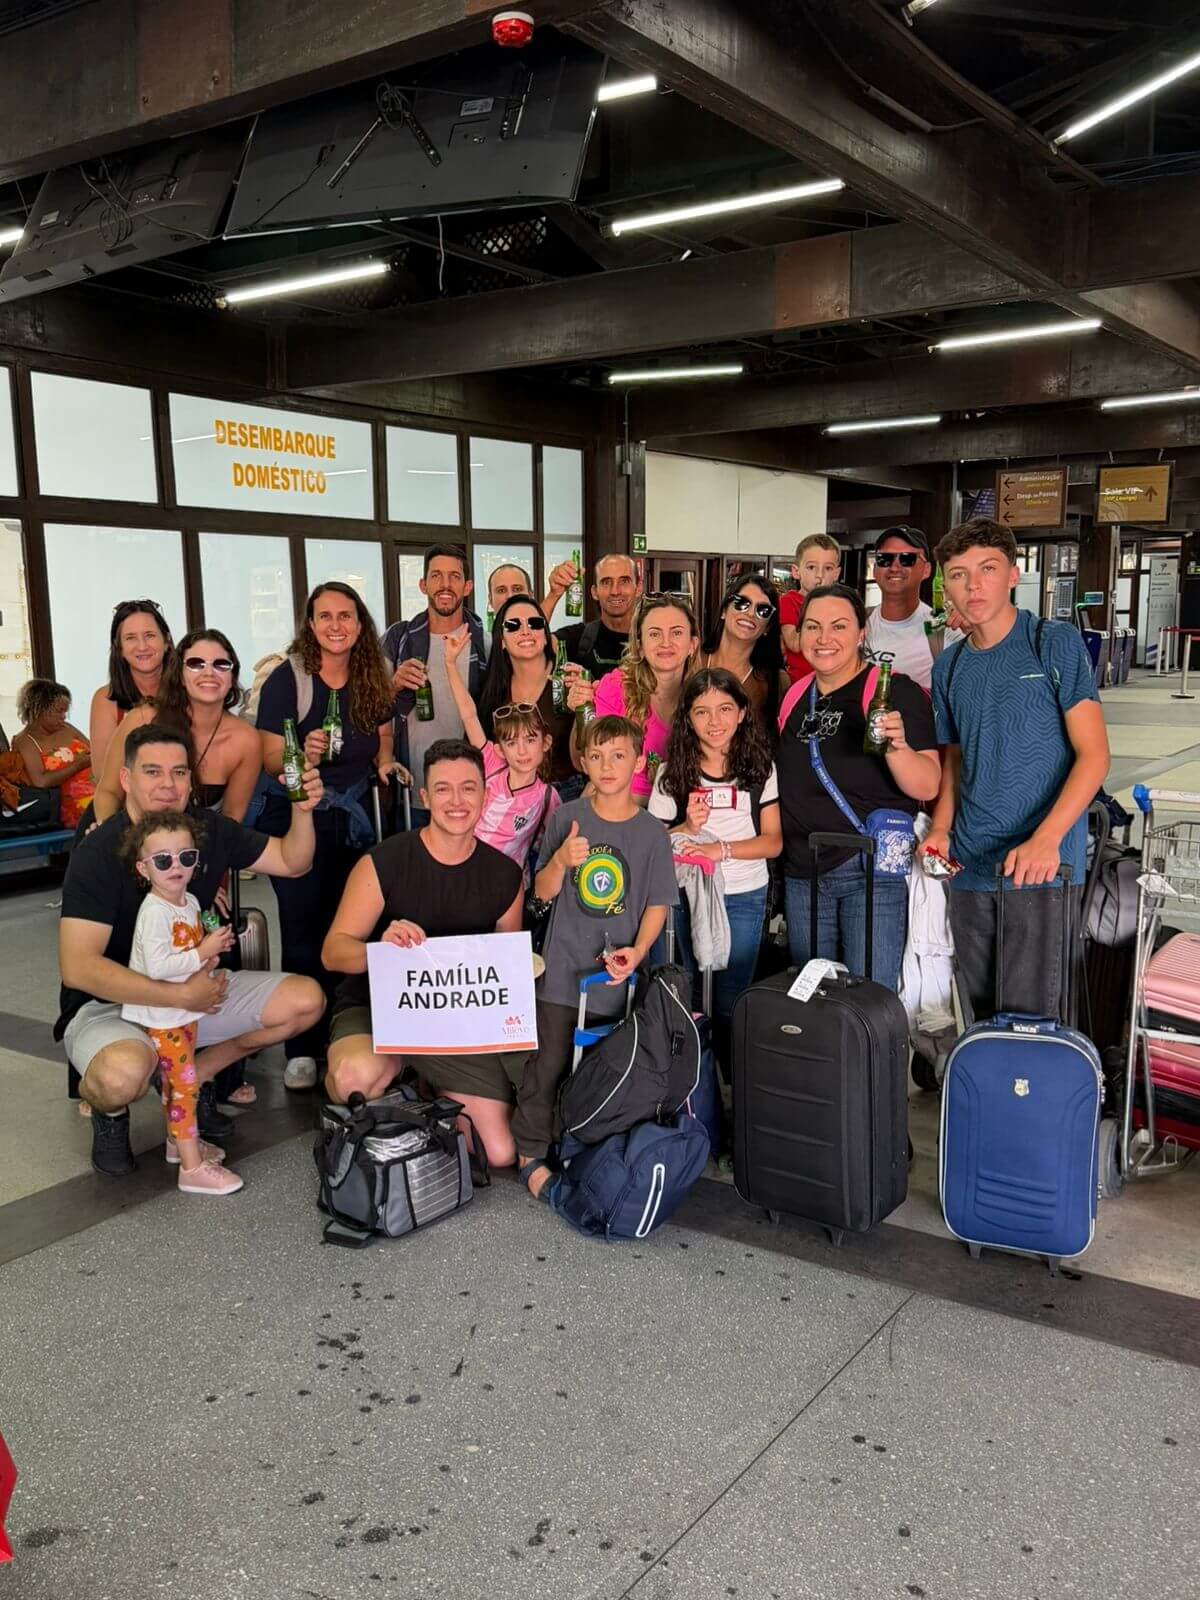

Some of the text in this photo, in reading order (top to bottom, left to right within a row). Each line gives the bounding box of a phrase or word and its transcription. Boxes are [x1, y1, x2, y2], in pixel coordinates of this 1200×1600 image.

[215, 420, 336, 459] DESEMBARQUE
[233, 461, 326, 494] DOMÉSTICO
[605, 902, 625, 914] Fé
[406, 963, 500, 987] FAMÍLIA
[397, 988, 509, 1009] ANDRADE
